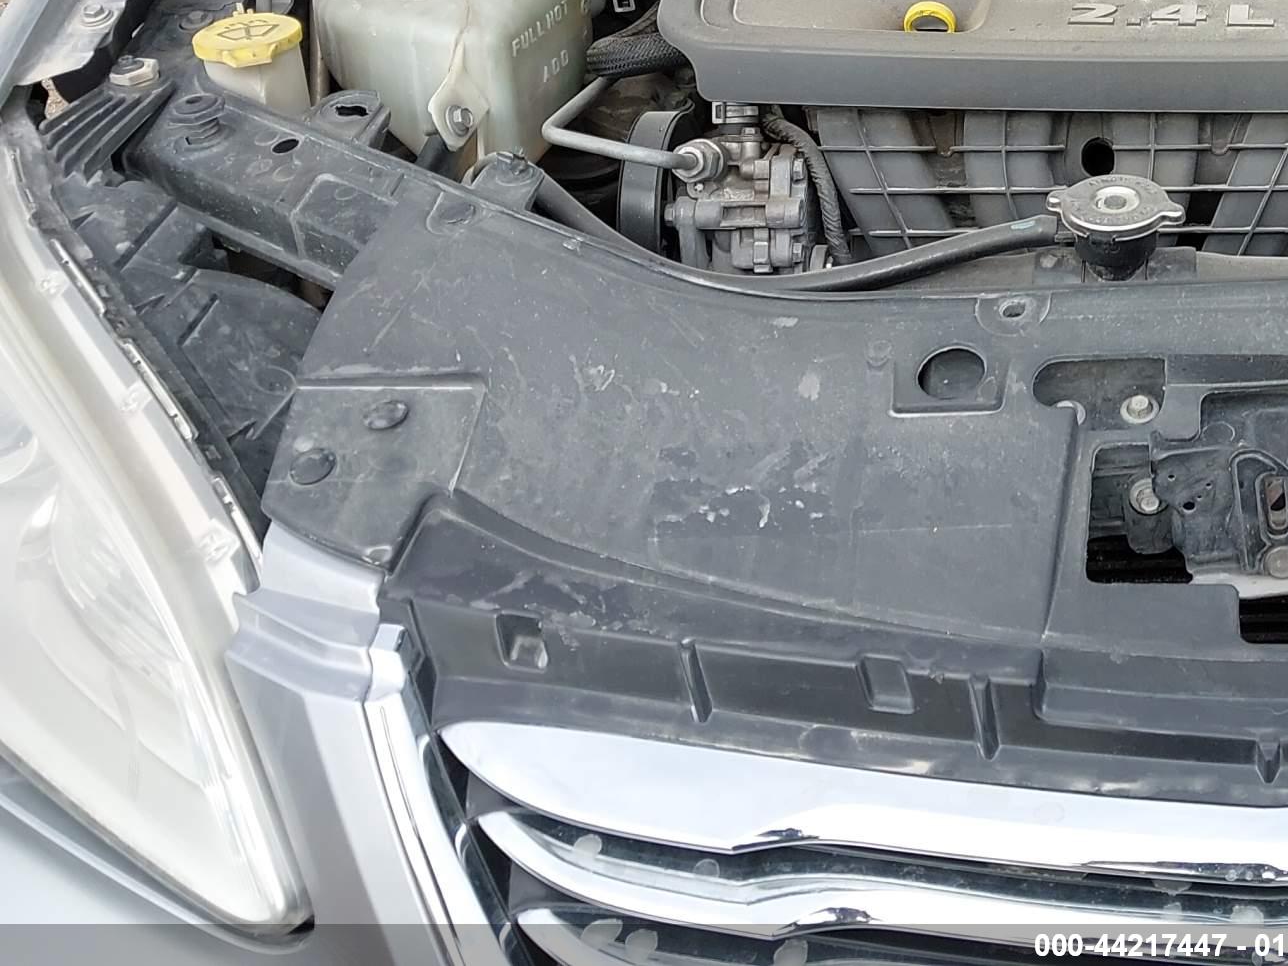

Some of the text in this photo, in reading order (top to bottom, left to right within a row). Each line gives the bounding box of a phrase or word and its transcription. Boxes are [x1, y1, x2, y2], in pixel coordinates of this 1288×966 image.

[1066, 2, 1275, 27] 2.4 L
[511, 20, 545, 58] FULL
